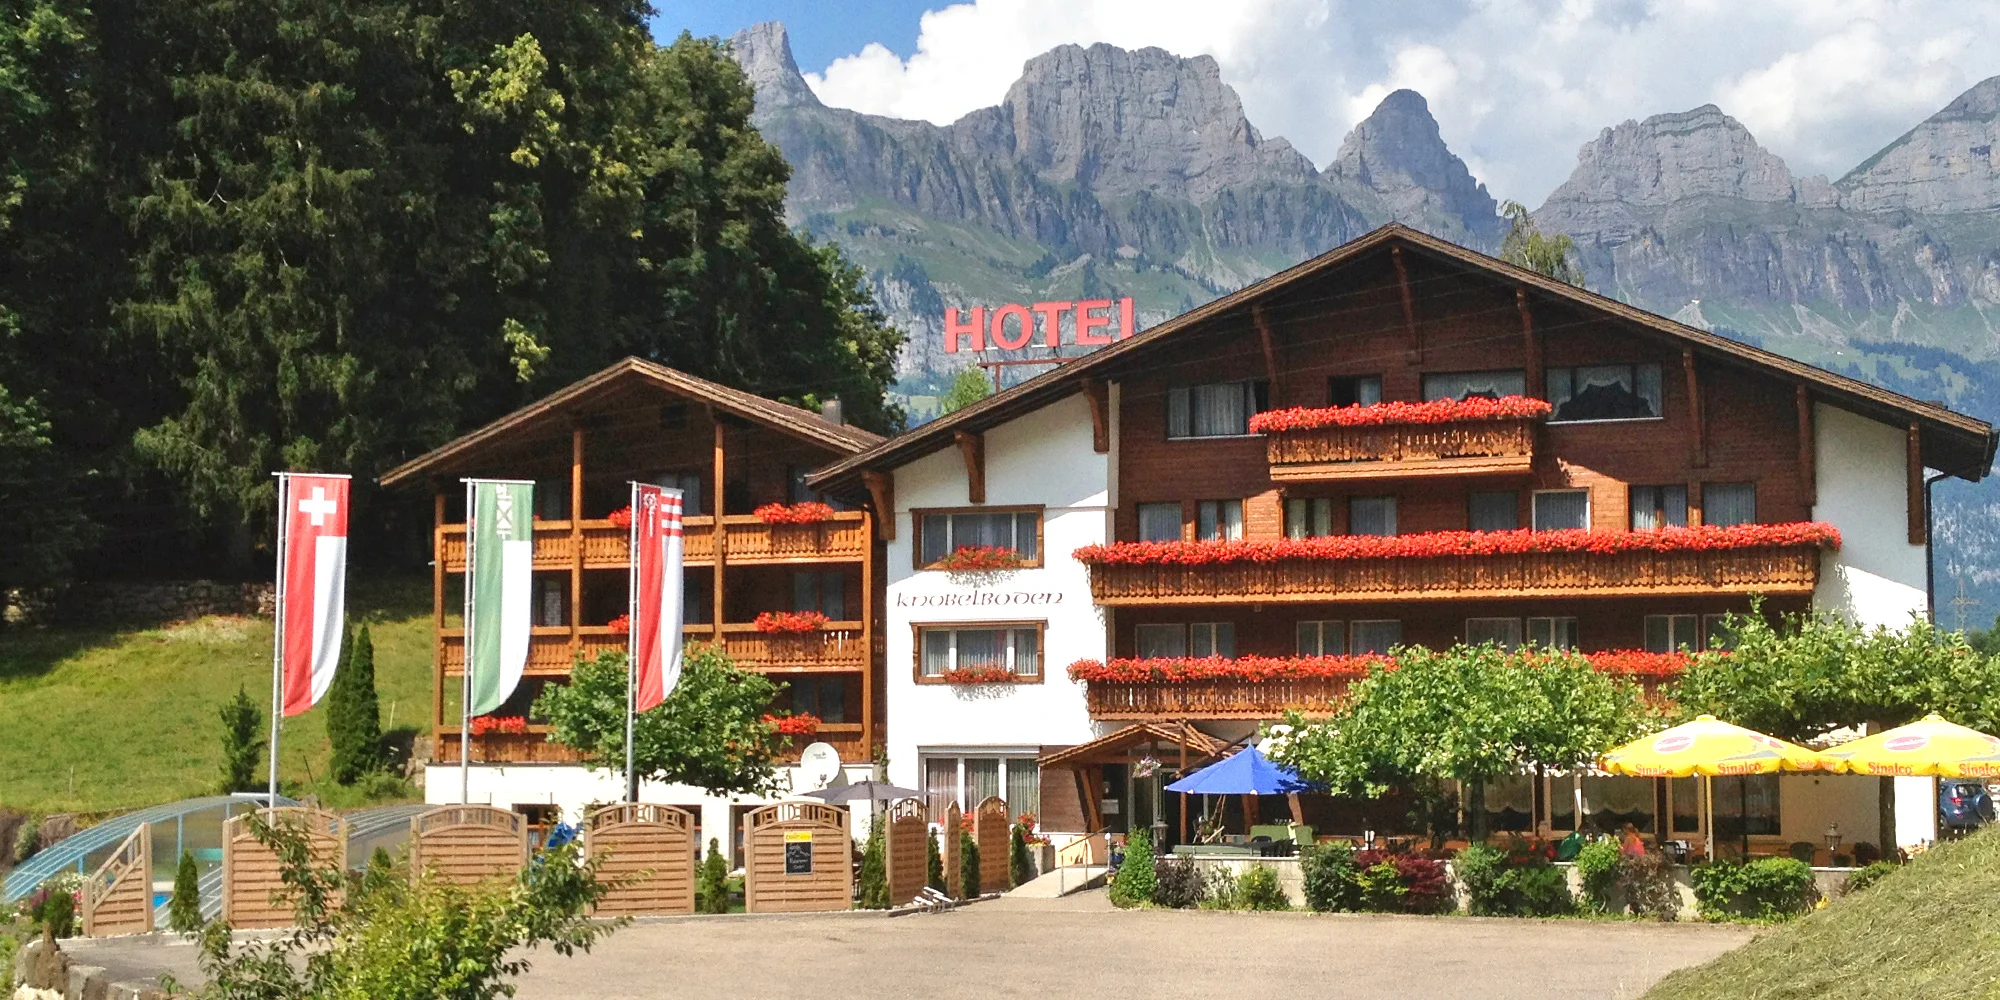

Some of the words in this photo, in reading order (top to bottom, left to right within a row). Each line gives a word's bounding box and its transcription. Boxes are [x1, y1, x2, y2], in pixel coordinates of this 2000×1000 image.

[1635, 764, 1673, 776] Sinalco
[1717, 760, 1762, 775] Sinalco
[1868, 762, 1912, 775] Sinalco
